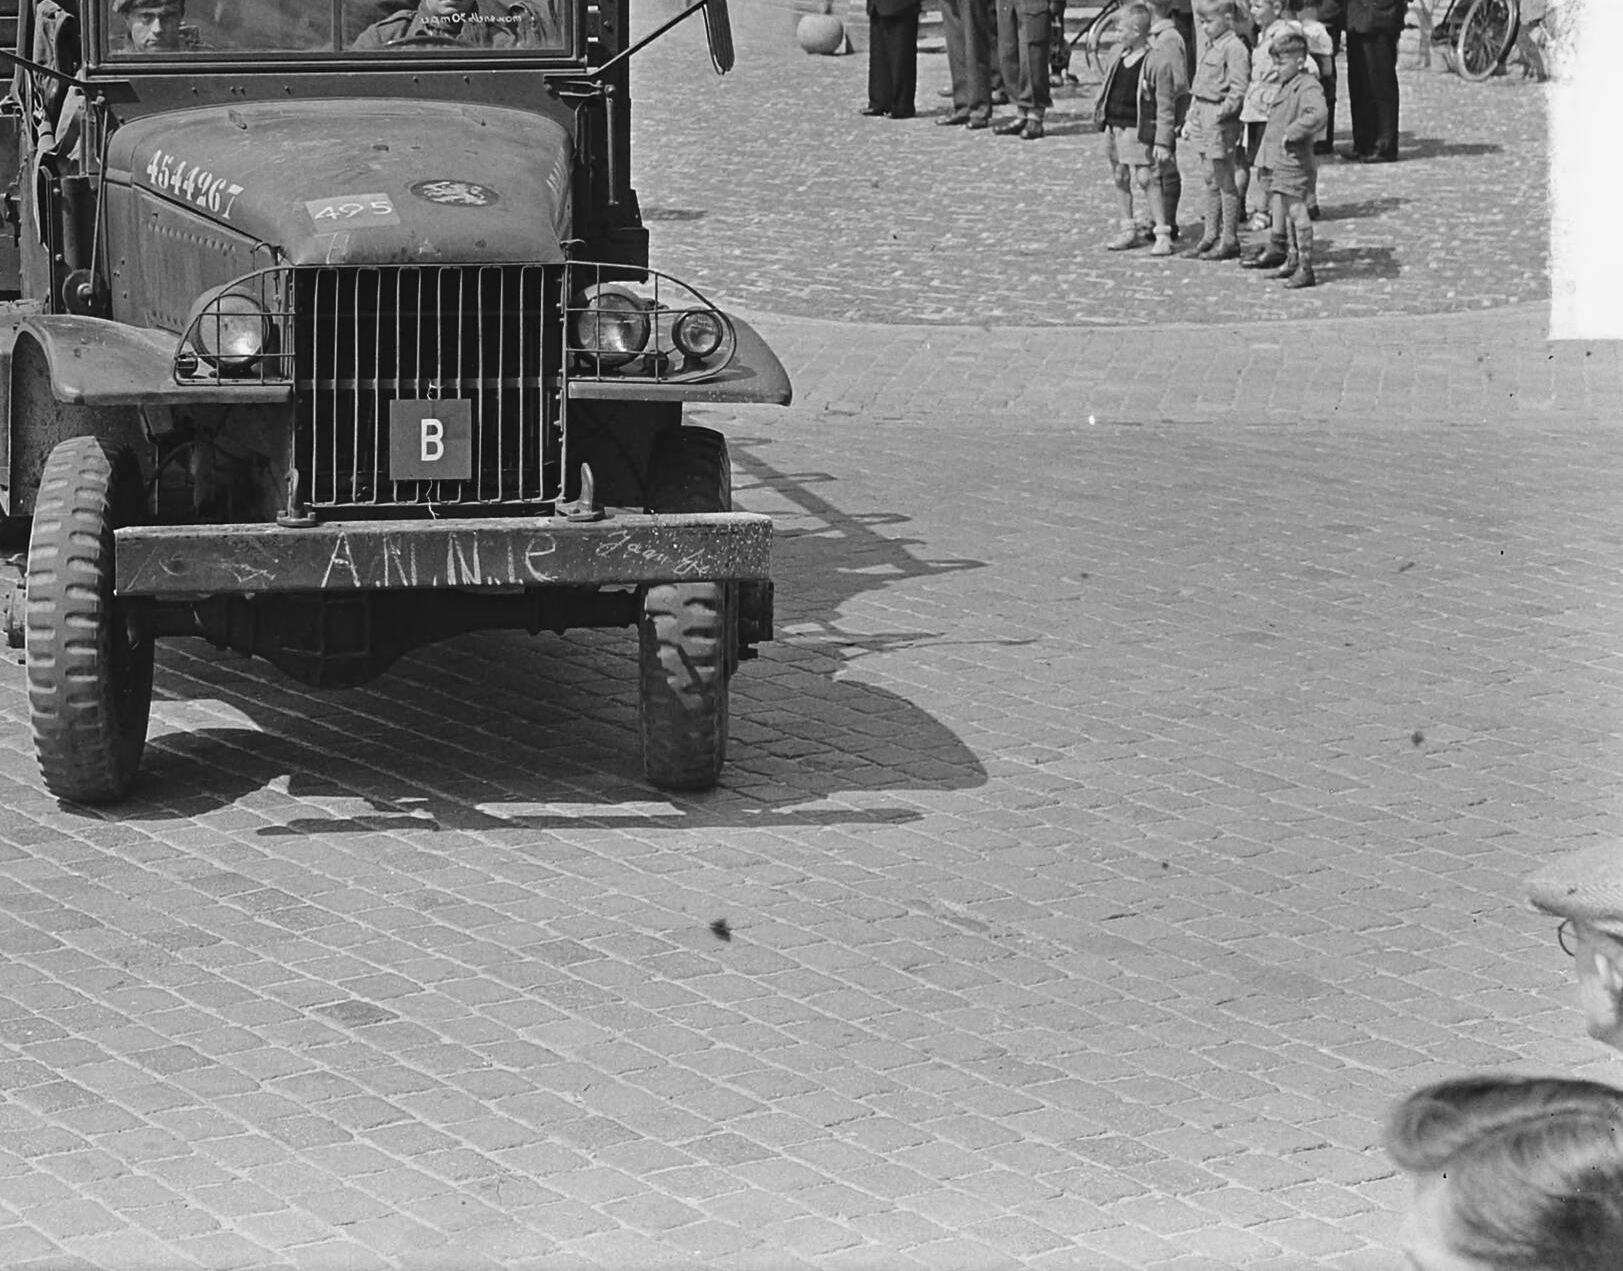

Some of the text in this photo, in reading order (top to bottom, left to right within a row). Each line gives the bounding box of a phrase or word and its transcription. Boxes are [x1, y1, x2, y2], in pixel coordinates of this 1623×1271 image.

[146, 149, 244, 220] 4544267
[314, 200, 393, 220] 495
[421, 418, 444, 461] B
